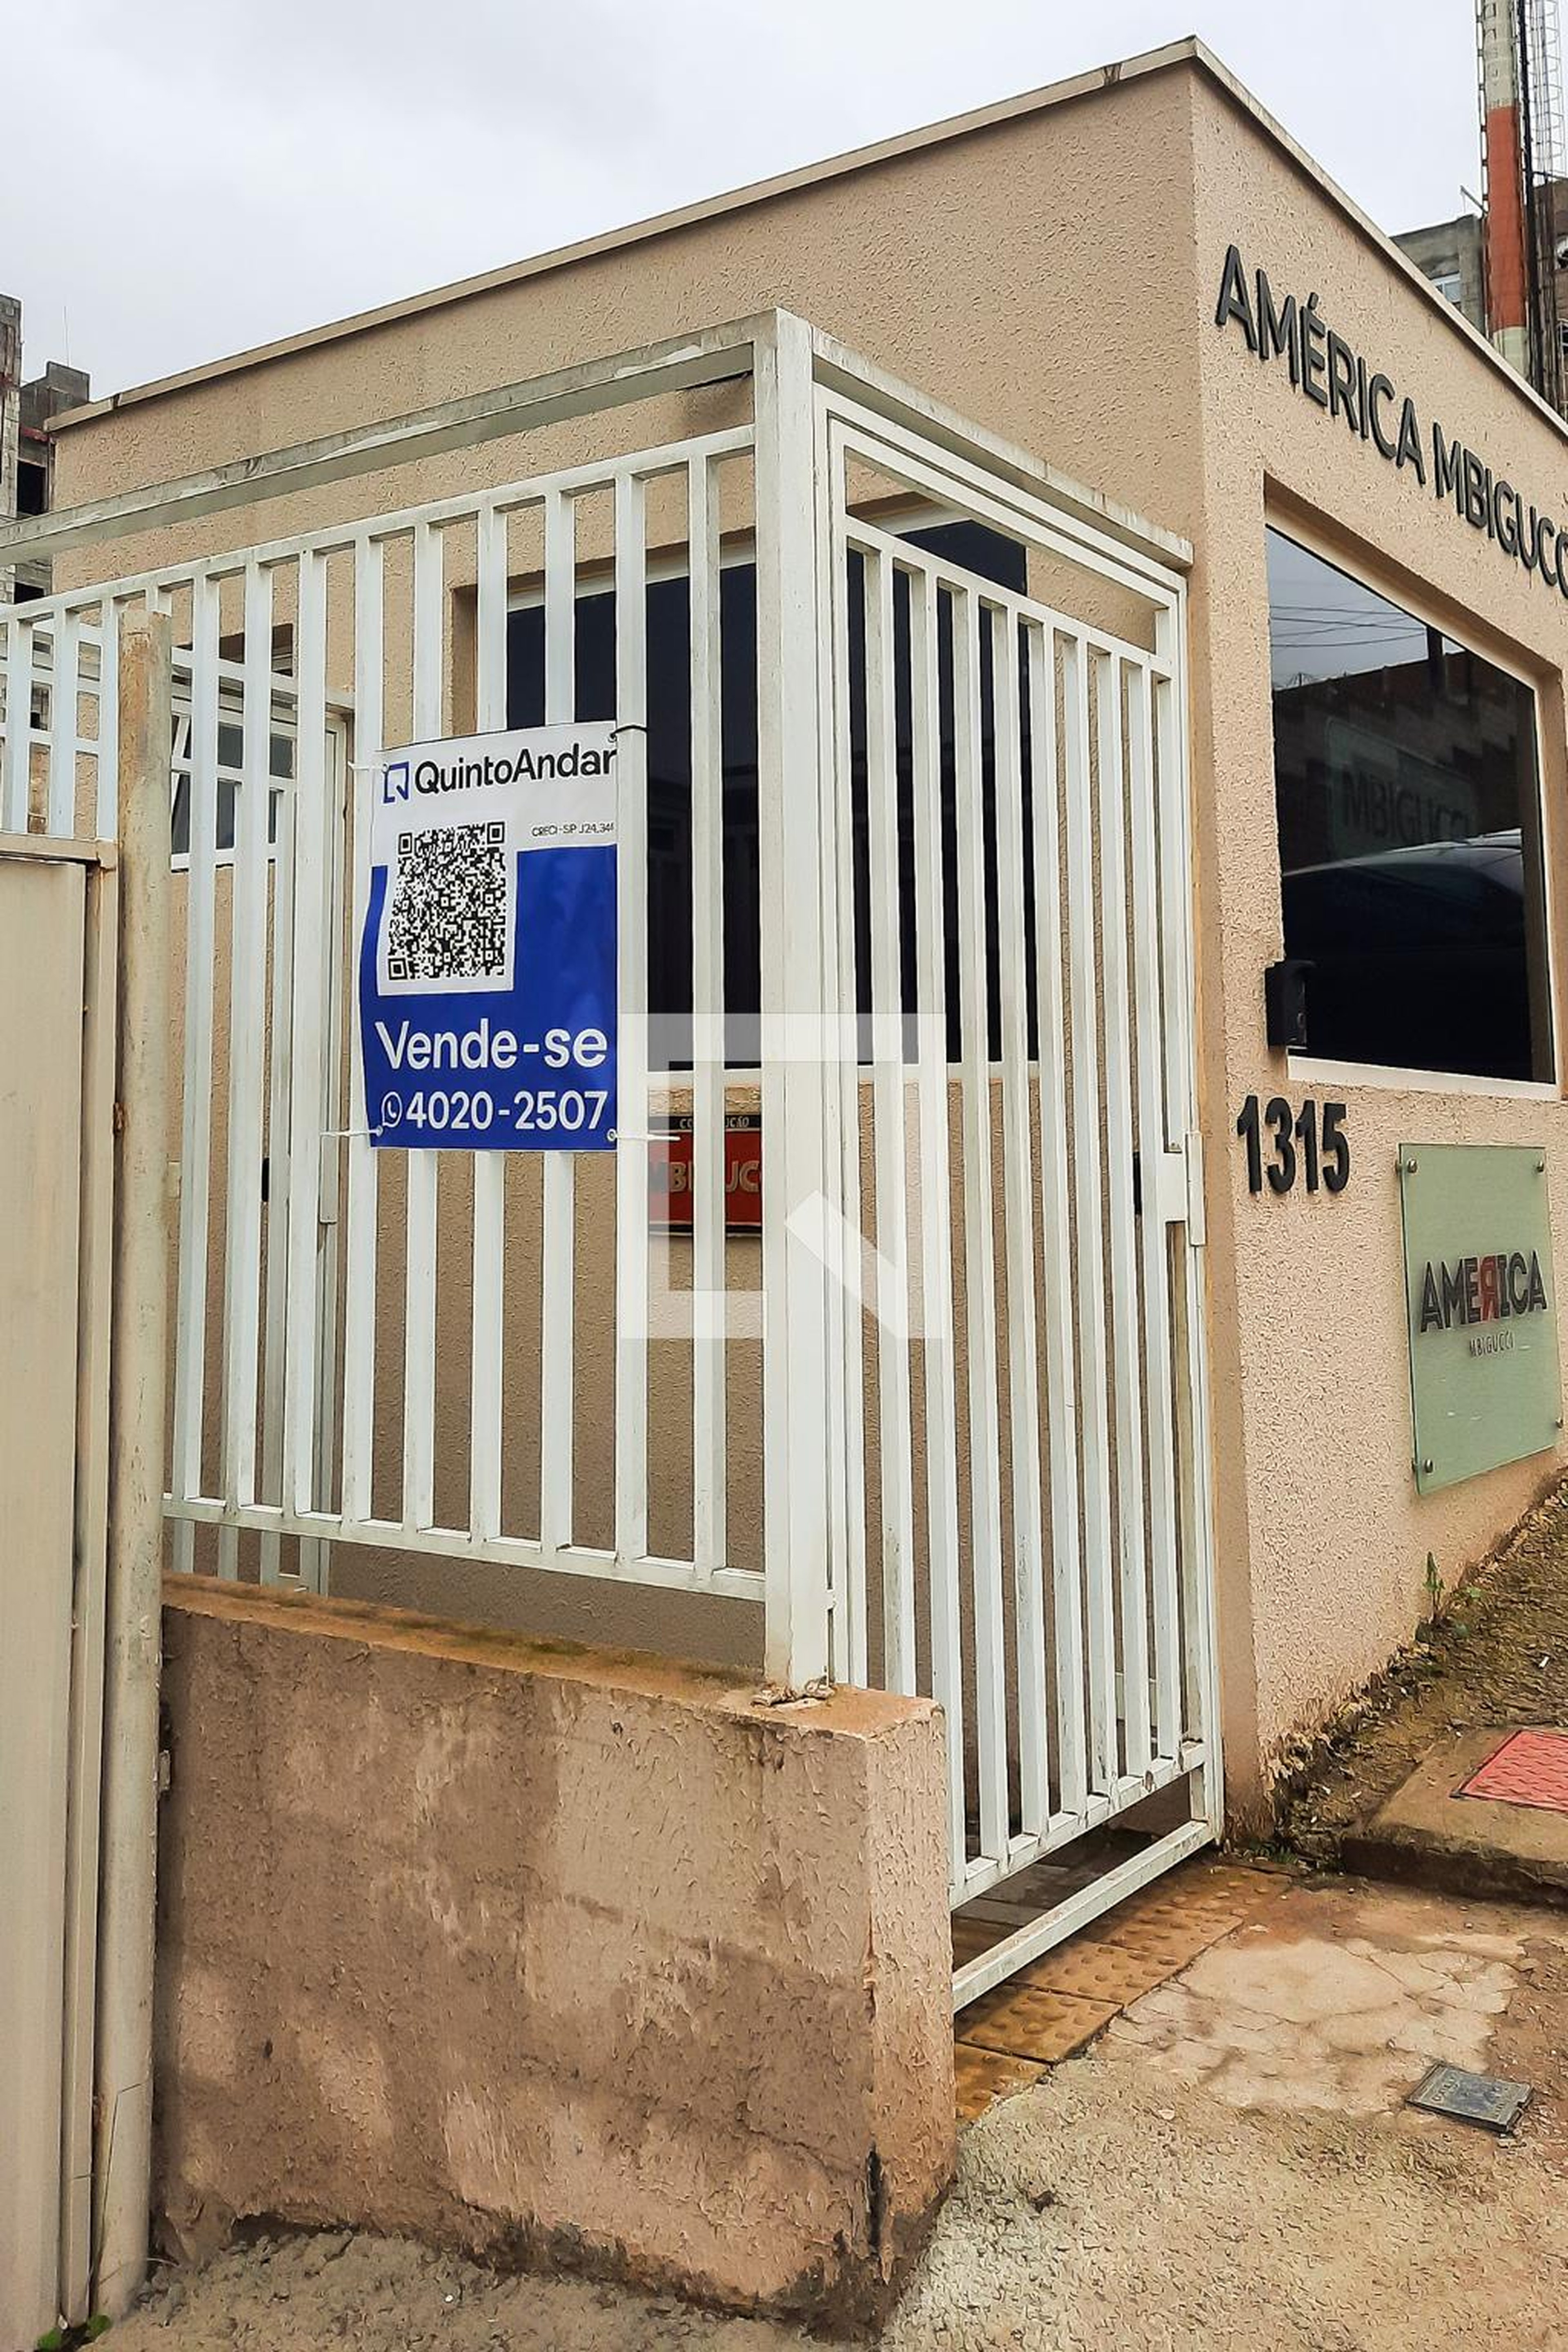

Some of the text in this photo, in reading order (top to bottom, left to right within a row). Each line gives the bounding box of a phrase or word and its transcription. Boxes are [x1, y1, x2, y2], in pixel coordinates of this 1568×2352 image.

[1215, 244, 1426, 485] AMÉRICA
[415, 743, 617, 794] QuintoAndar
[375, 1018, 607, 1069] Vende-se
[406, 1091, 608, 1130] 4020-2507
[1237, 1095, 1350, 1194] 1315
